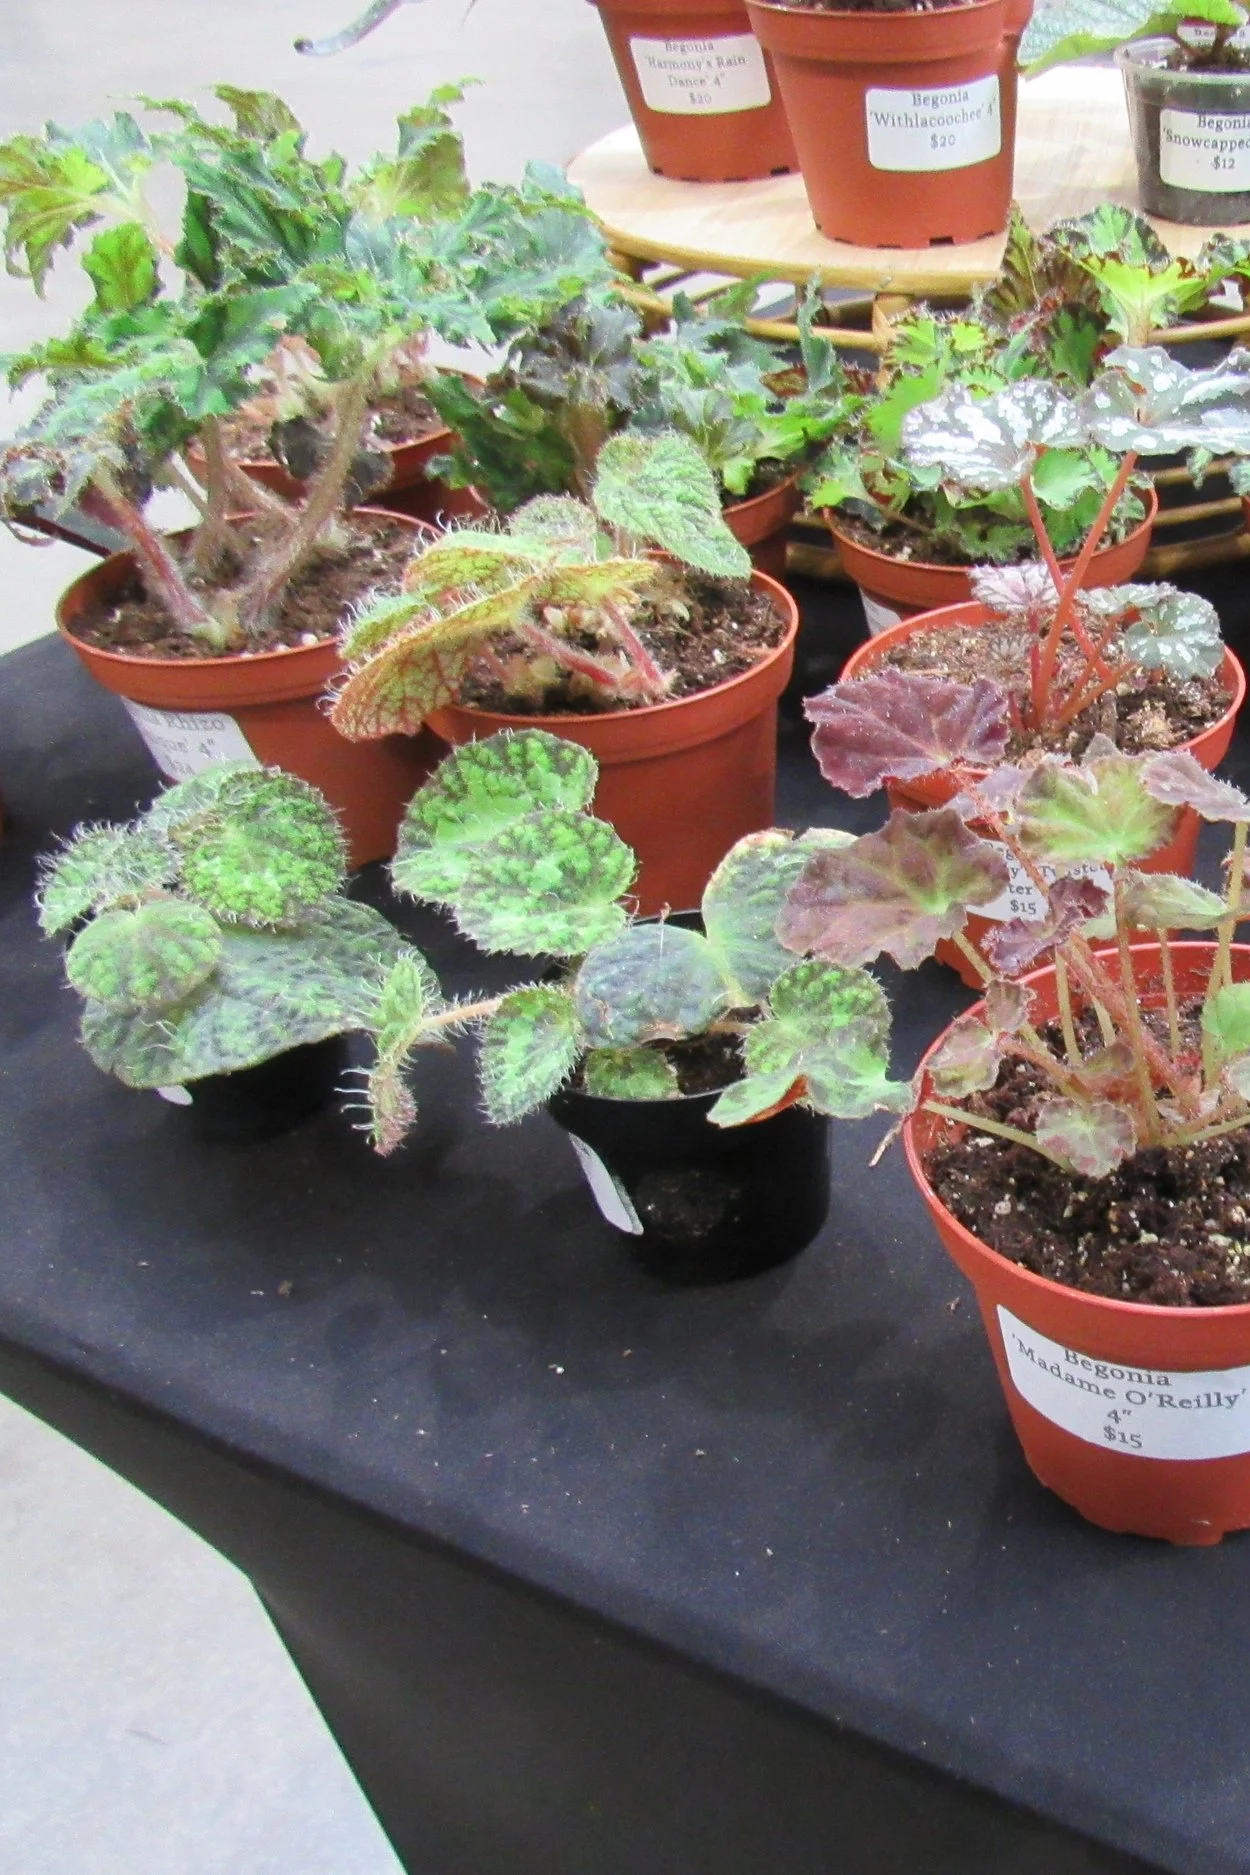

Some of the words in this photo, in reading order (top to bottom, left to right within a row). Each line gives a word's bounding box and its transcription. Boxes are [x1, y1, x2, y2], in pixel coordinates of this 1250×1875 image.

[716, 56, 746, 69] Rain
[912, 90, 969, 109] Begonia
[930, 133, 956, 149] $20
[1212, 155, 1235, 170] $12
[1009, 899, 1037, 915] $15
[1064, 1349, 1172, 1387] Begonia
[1107, 1408, 1132, 1425] 4"
[1103, 1425, 1143, 1449] $15
